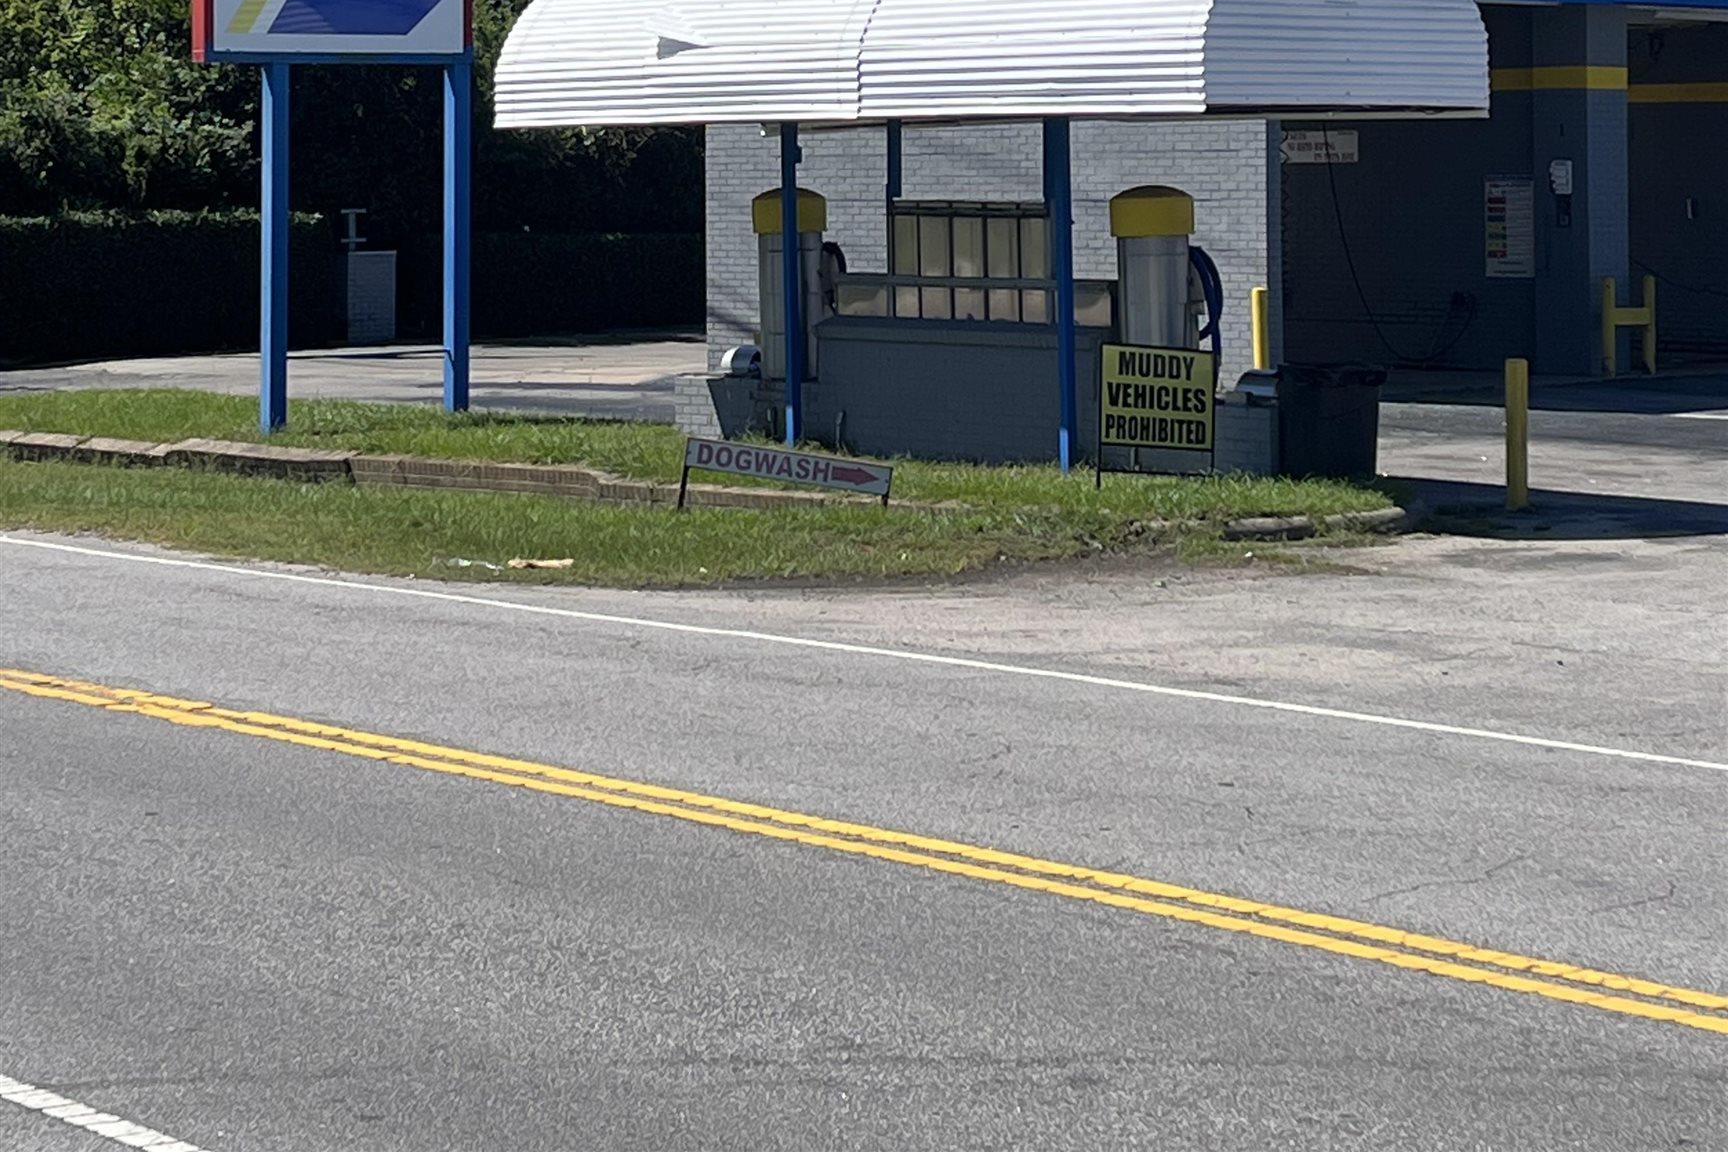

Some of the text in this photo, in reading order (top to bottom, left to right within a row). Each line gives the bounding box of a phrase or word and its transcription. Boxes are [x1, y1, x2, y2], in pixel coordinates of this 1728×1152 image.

[1118, 351, 1195, 381] MUDDY
[1107, 381, 1206, 414] VEHICLES
[1104, 413, 1206, 445] PROHIBITED
[696, 443, 831, 483] DOGWASH
